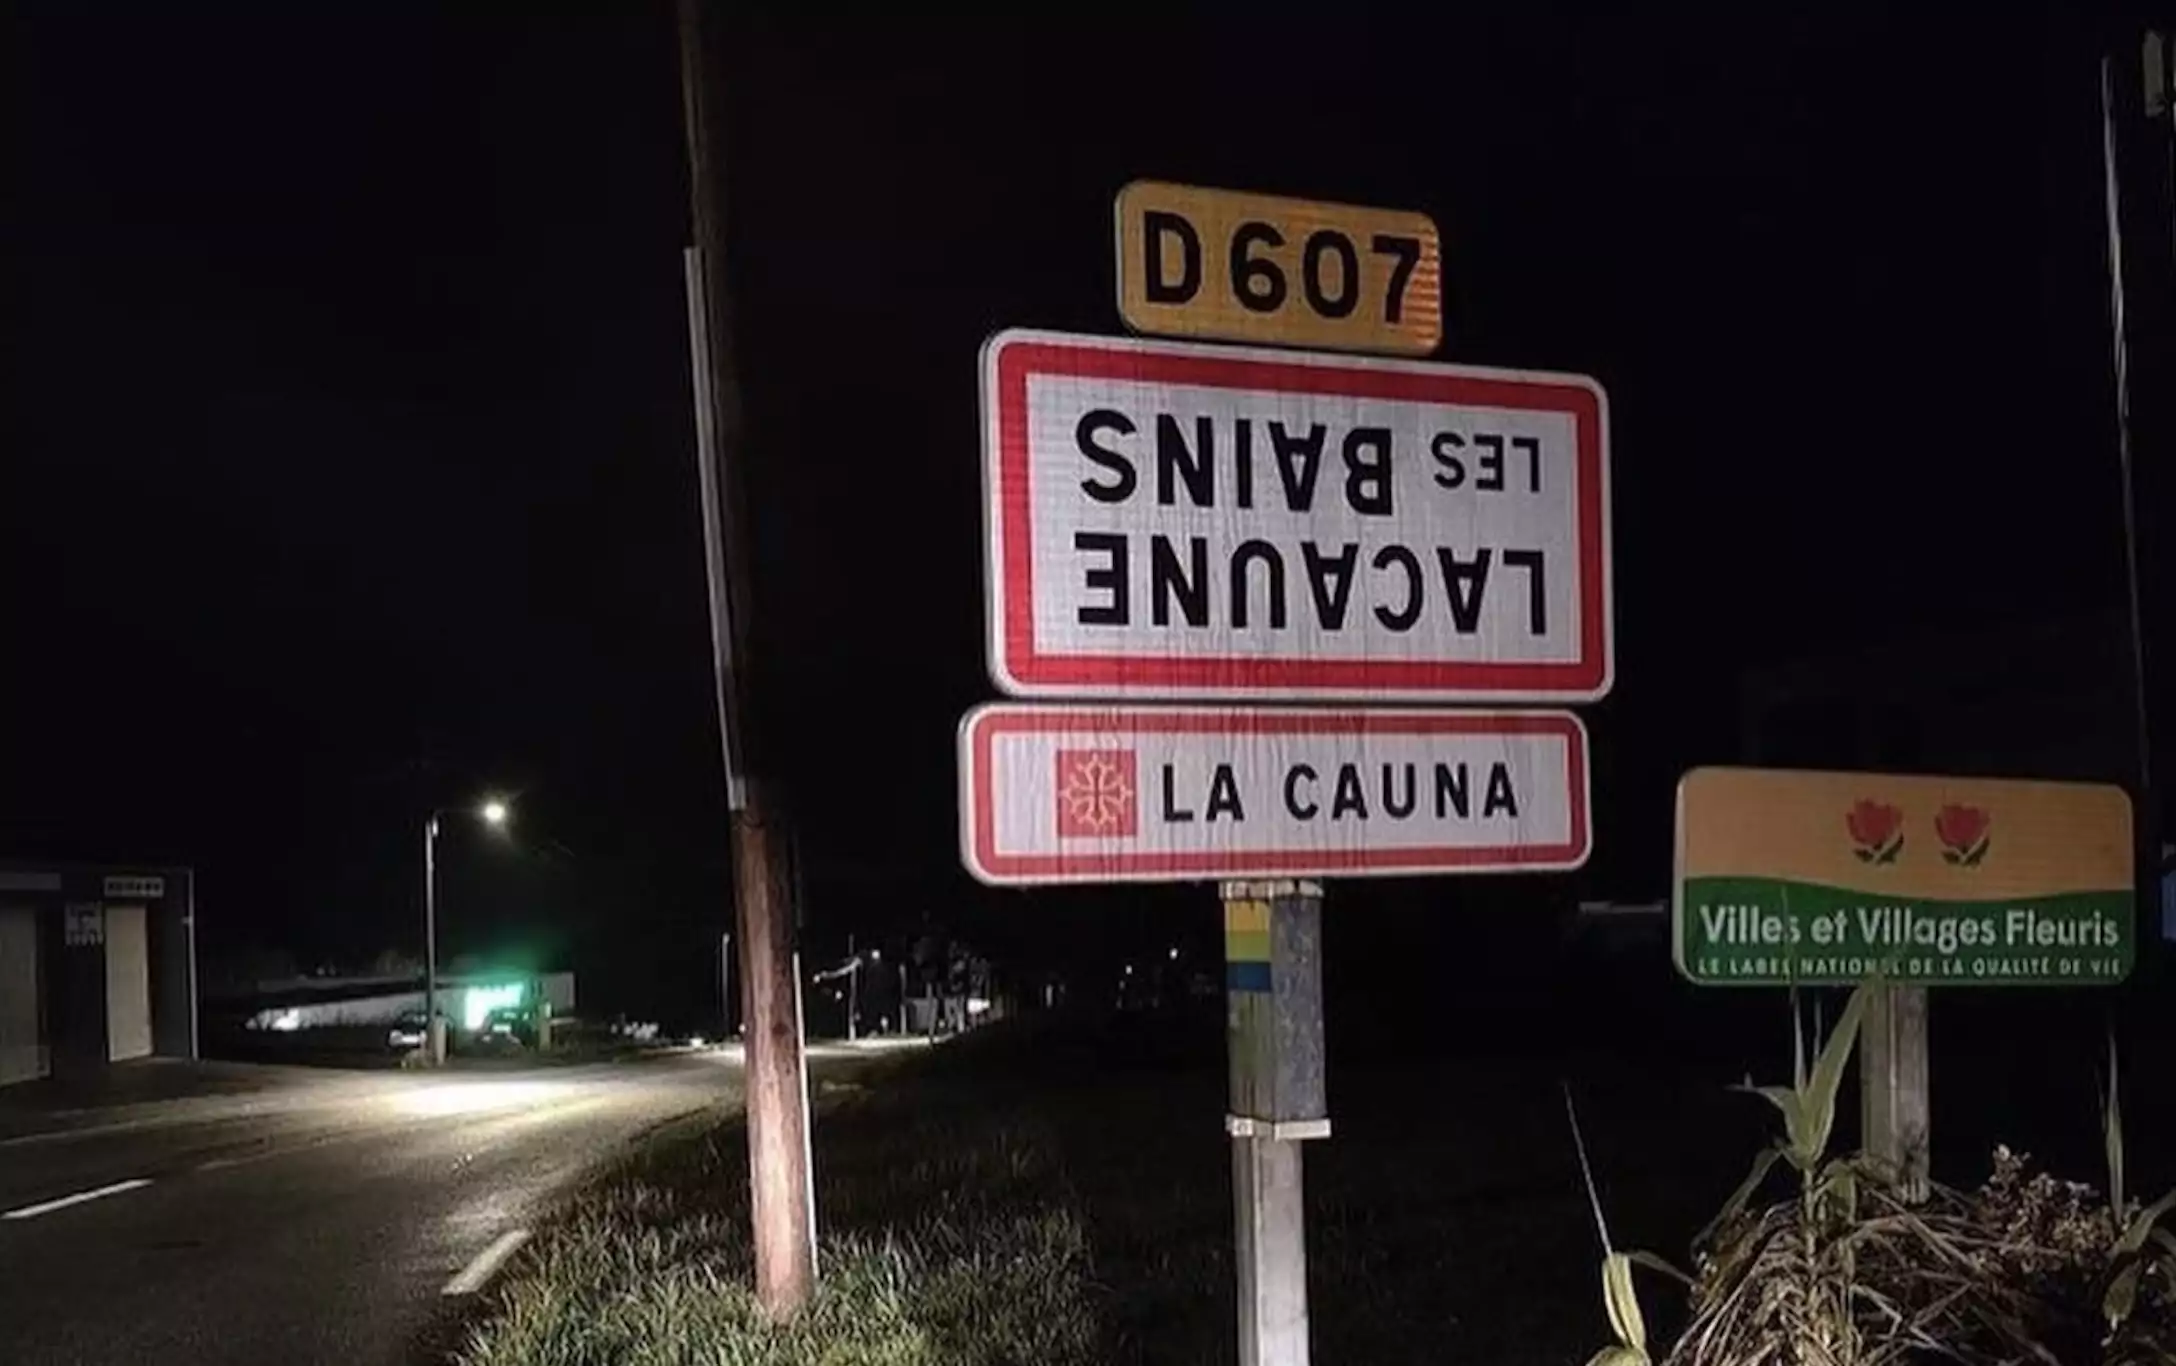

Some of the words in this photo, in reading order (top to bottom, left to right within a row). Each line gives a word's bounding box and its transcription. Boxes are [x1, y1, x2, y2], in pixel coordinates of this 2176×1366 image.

[1142, 210, 1202, 305] D
[1229, 221, 1421, 324] 607
[1075, 409, 1393, 517] BAINS
[1430, 432, 1541, 494] LES
[1074, 532, 1547, 636] LACAUNE
[1162, 763, 1245, 822] LA
[1284, 762, 1519, 821] CAUNA
[1699, 904, 1801, 944] Villes
[1811, 909, 1849, 944] et
[1857, 906, 1997, 955] Villages
[2005, 908, 2120, 946] Fleuris
[1698, 957, 1719, 975] LE
[1800, 957, 1899, 975] NATIONL
[1909, 957, 1933, 975] DE
[1942, 957, 1964, 976] LA
